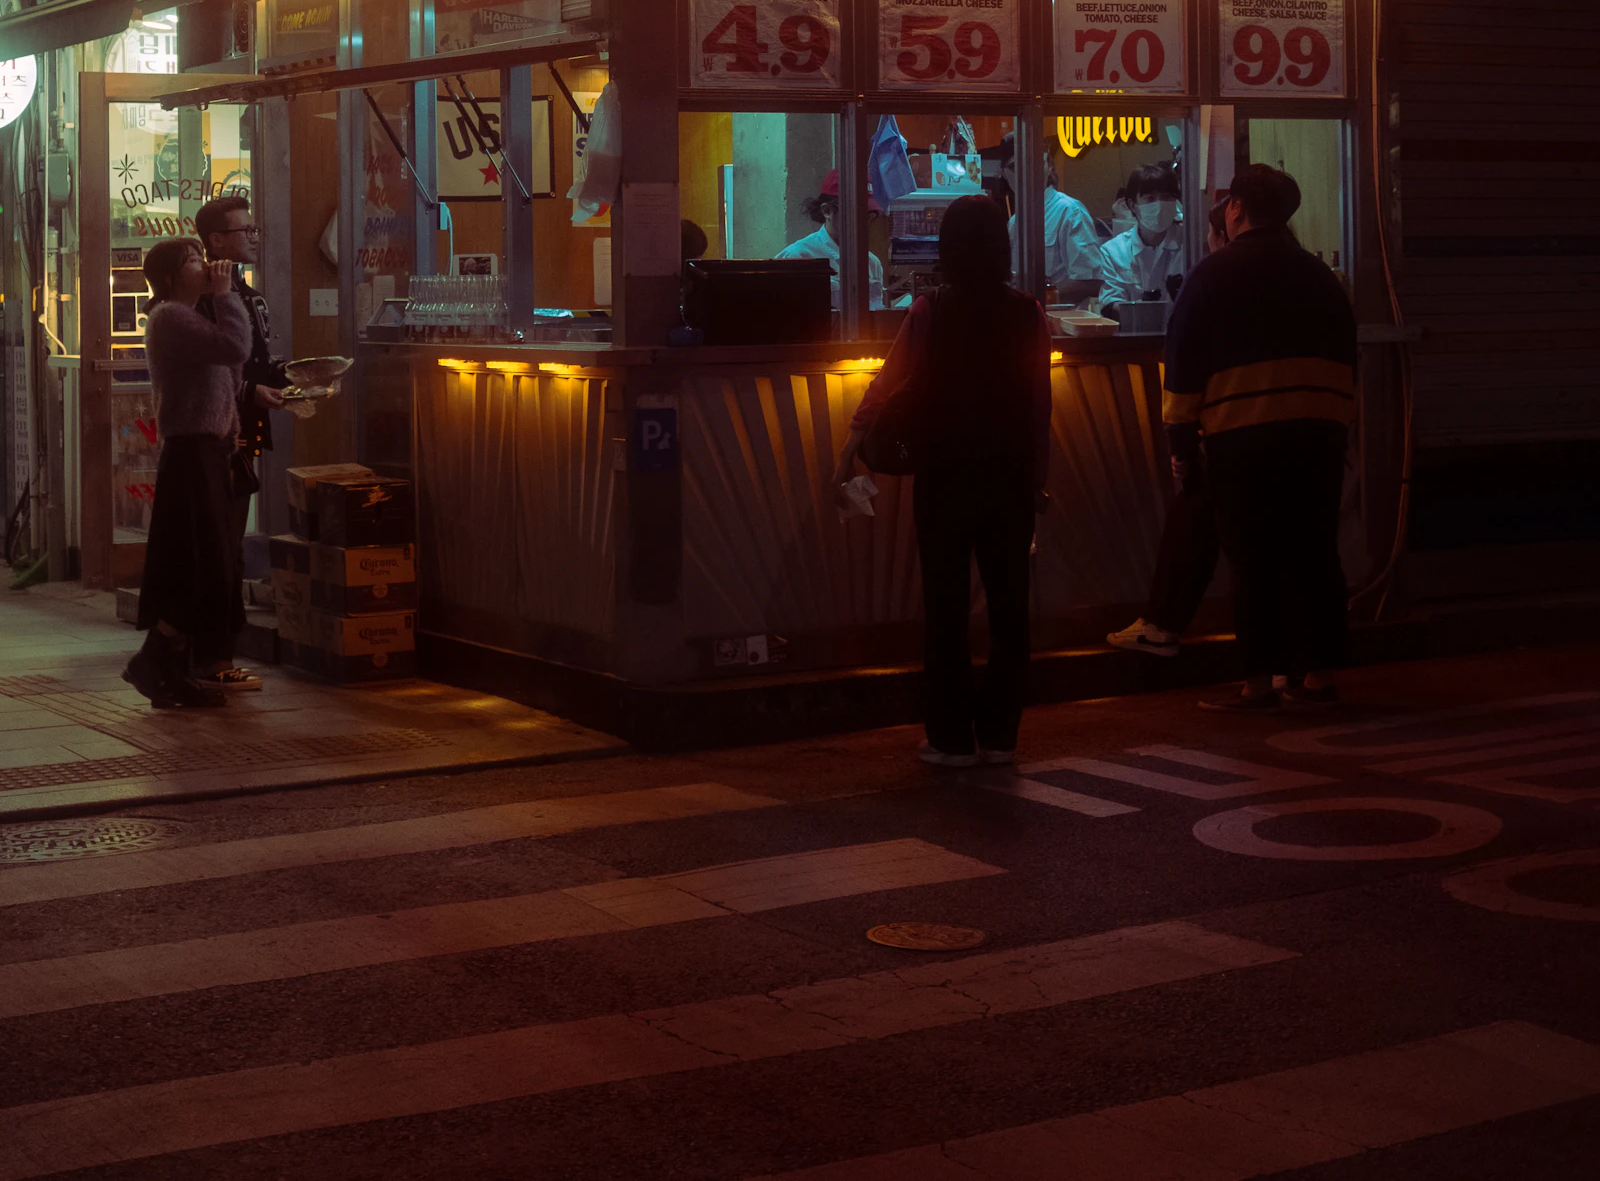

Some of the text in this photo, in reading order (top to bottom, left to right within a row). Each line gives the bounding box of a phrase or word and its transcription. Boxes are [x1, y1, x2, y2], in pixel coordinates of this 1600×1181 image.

[1123, 14, 1159, 24] CHEESE
[1269, 10, 1297, 19] SALSA
[1298, 11, 1327, 21] SAUCE
[702, 5, 831, 77] 4.9
[896, 14, 1001, 80] 5.9
[1074, 28, 1165, 83] 7.0
[1233, 24, 1331, 87] 9.9
[116, 253, 139, 262] VISA
[642, 420, 662, 450] P
